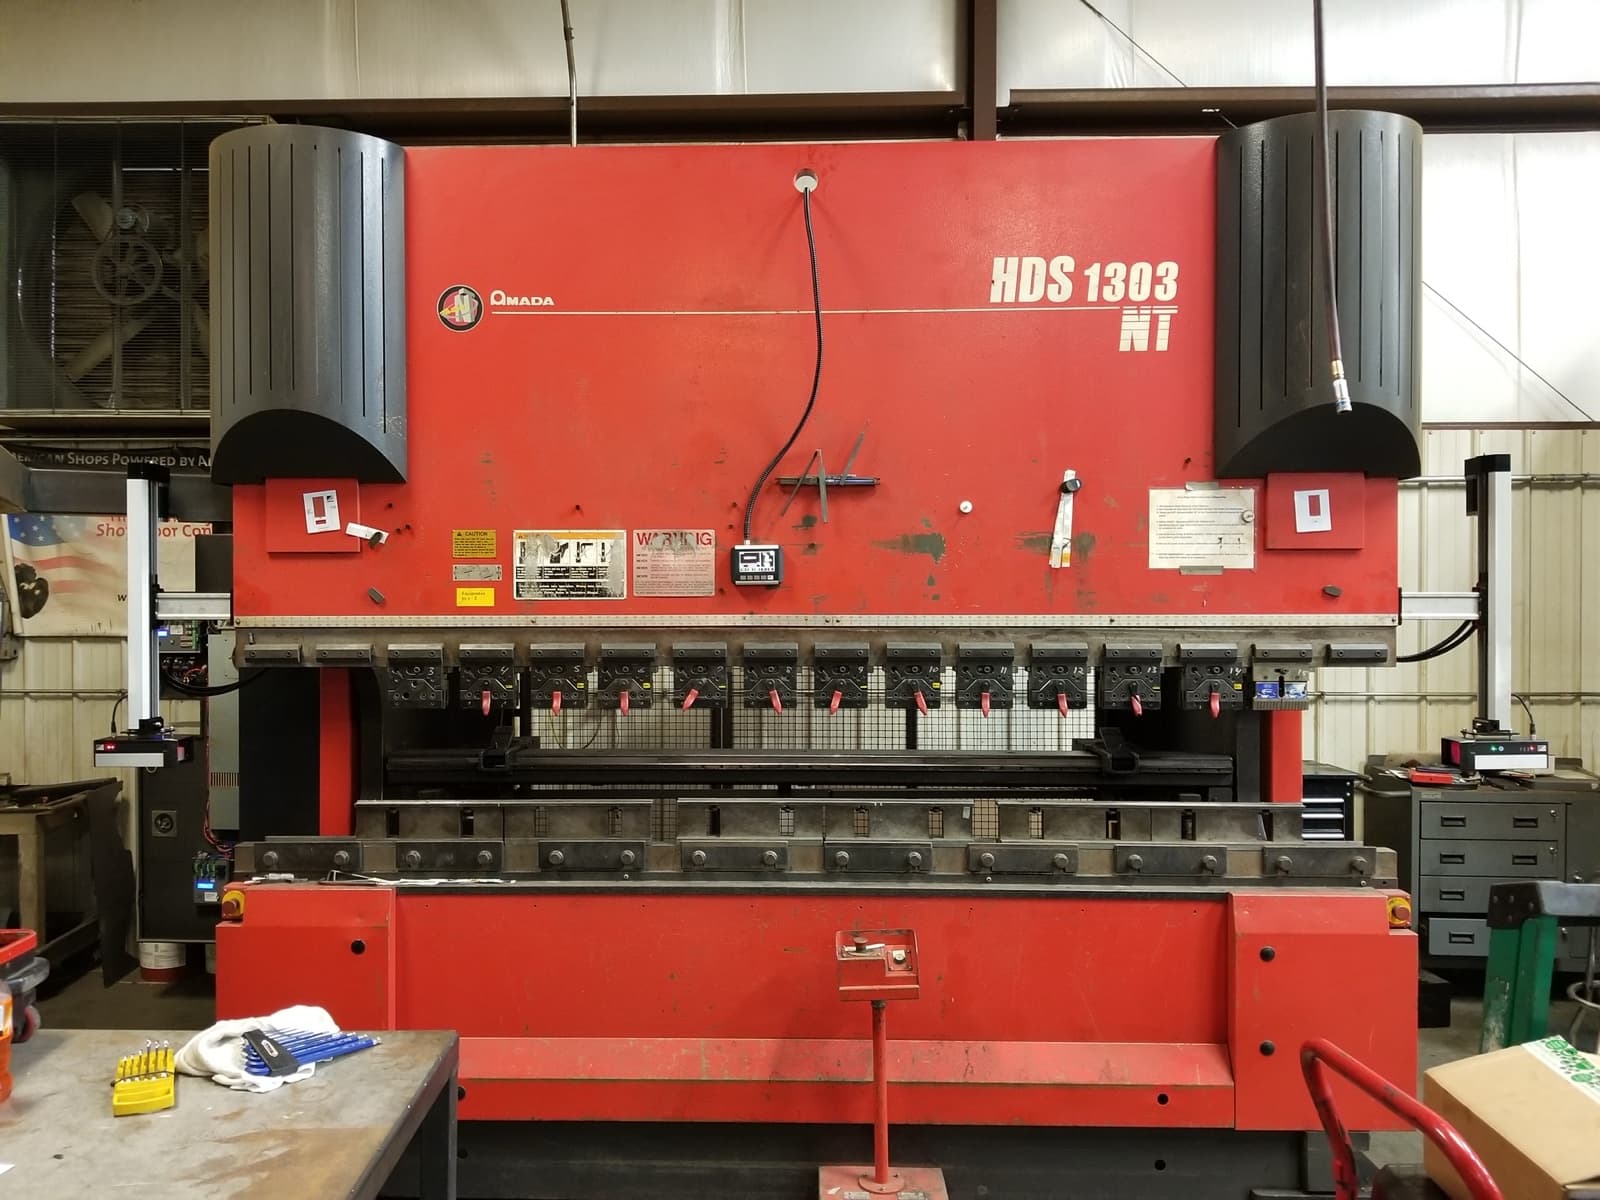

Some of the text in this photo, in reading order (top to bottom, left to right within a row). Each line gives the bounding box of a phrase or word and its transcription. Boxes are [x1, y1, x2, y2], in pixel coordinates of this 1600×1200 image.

[990, 255, 1179, 303] HDS 1303
[1119, 306, 1178, 352] NT
[96, 523, 128, 537] Sho
